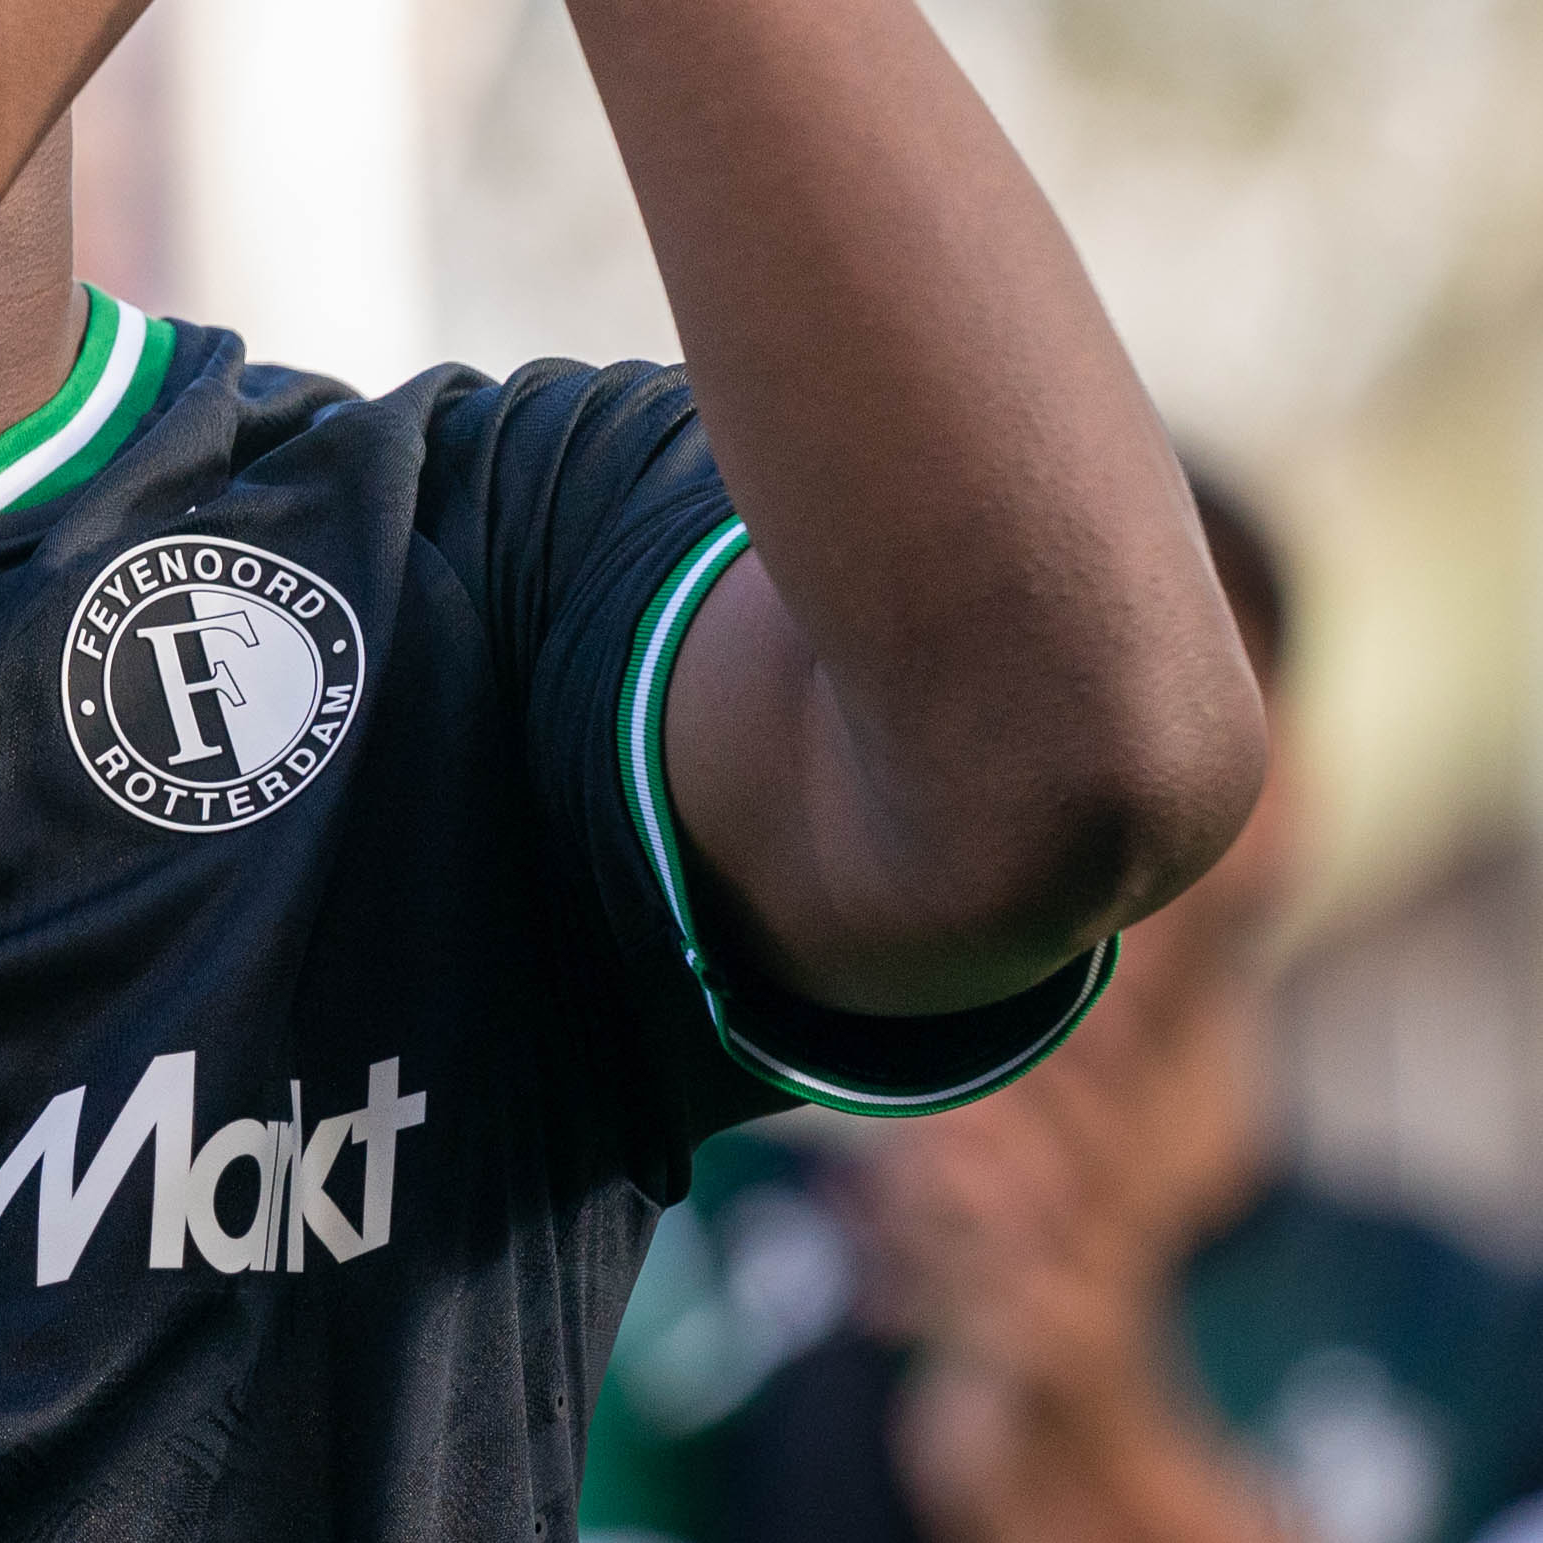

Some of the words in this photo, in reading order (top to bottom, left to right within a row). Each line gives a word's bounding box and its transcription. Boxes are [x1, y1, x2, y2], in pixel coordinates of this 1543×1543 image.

[75, 547, 327, 661] FEYENOORD
[94, 683, 354, 822] ROTTERDAM
[135, 610, 261, 767] F
